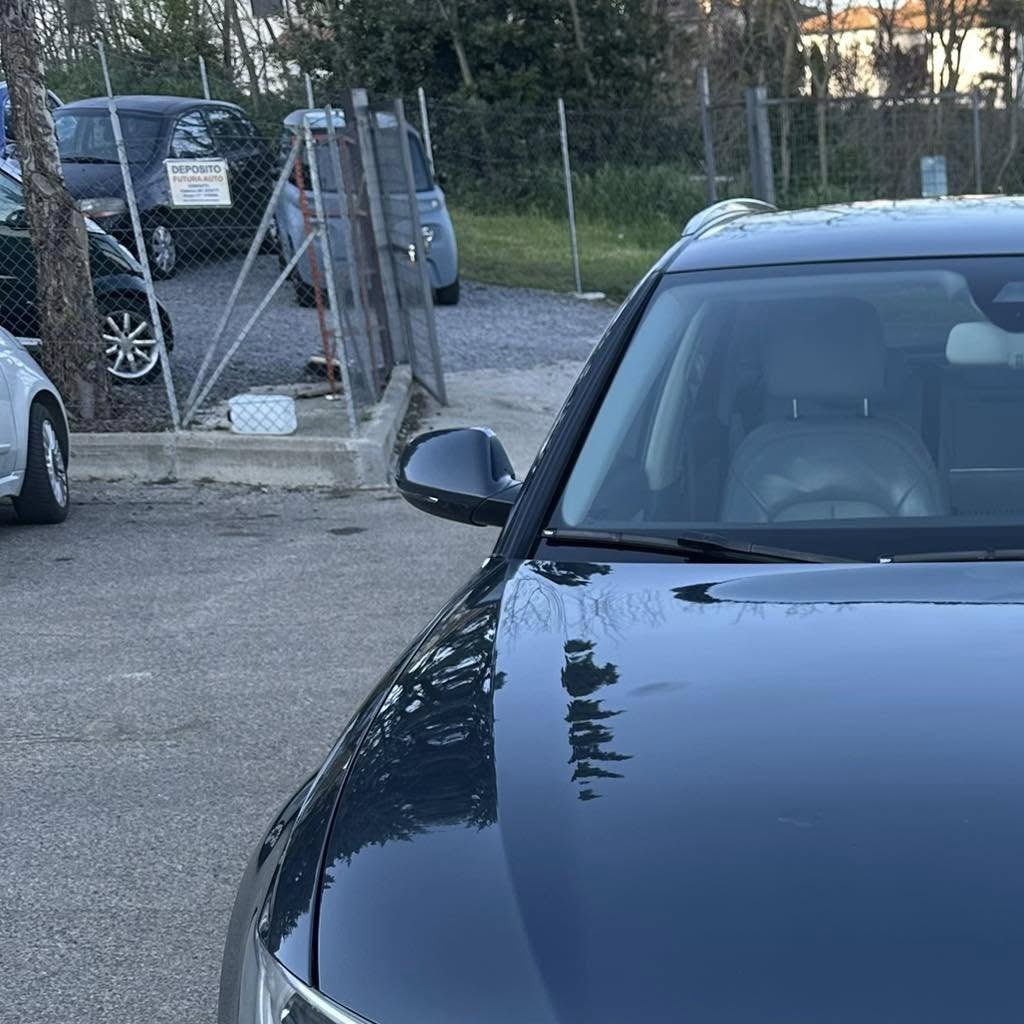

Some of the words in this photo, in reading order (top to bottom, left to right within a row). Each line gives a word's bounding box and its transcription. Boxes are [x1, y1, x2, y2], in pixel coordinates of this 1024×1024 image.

[171, 164, 221, 174] DEPOSITO
[172, 175, 202, 183] FUTURA
[203, 175, 224, 183] AUTO
